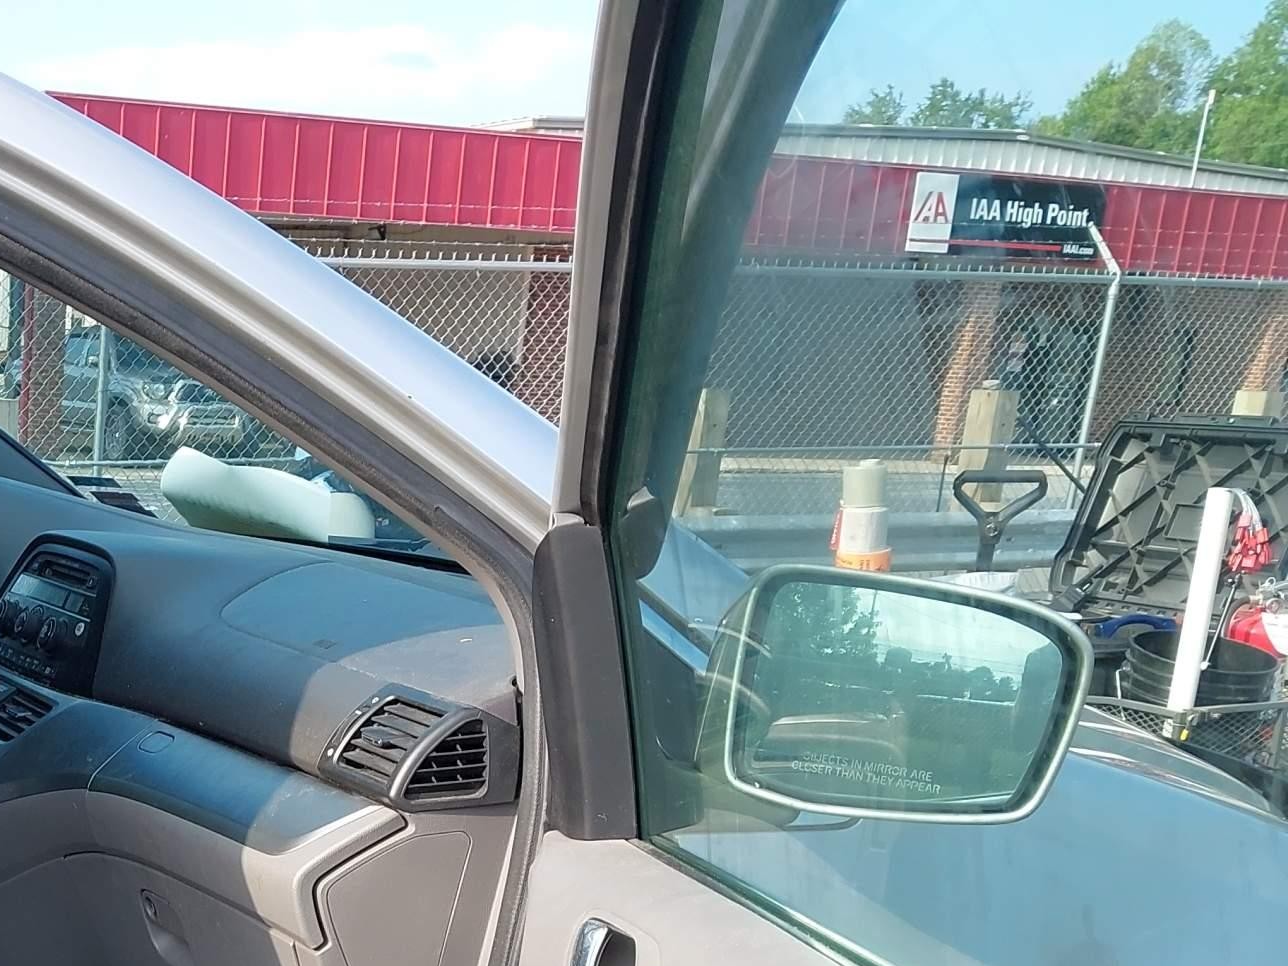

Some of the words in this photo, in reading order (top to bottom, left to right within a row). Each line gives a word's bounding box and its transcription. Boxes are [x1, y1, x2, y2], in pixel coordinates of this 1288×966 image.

[970, 198, 1001, 221] IAA
[1005, 200, 1043, 228] High
[1046, 203, 1089, 227] Point
[792, 760, 832, 776] CLOSER
[835, 766, 863, 781] THAN
[866, 772, 894, 786] THEY
[895, 778, 941, 795] APPEAR
[850, 759, 862, 770] IN
[864, 761, 907, 777] MIRROR
[910, 769, 933, 782] ARE
